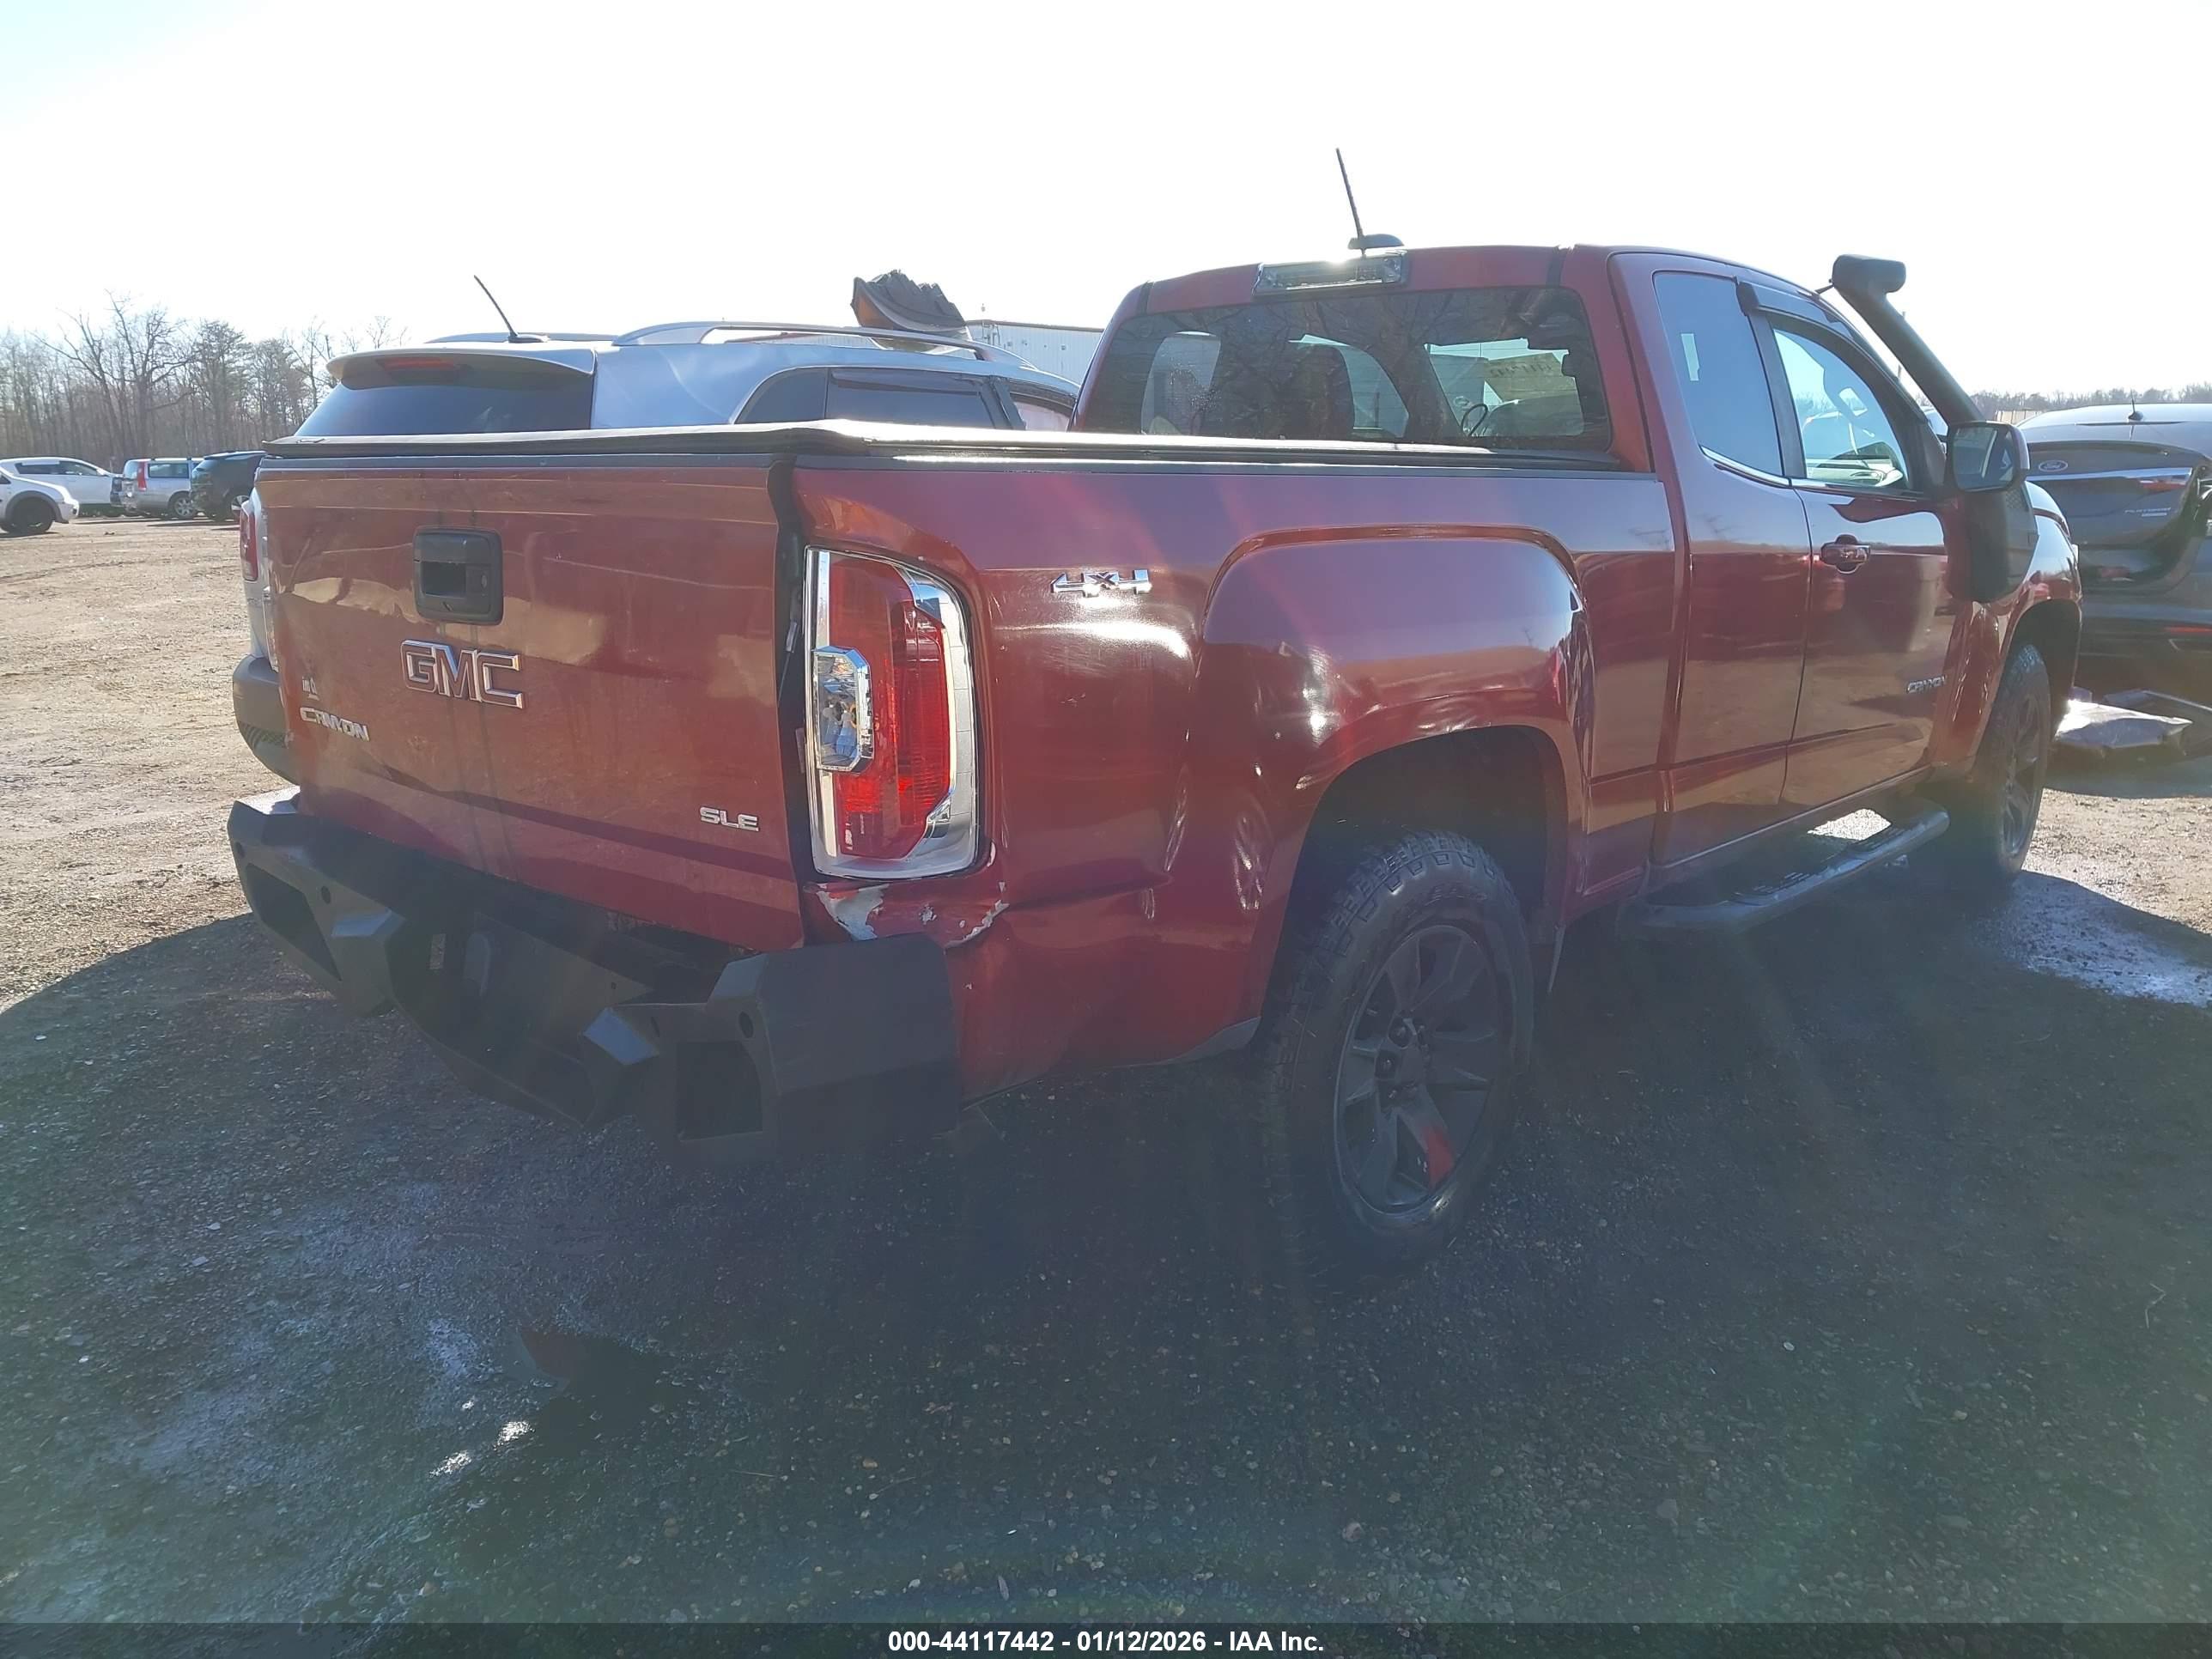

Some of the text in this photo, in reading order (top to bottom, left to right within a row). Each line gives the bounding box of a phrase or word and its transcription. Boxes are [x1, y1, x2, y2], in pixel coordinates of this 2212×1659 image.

[400, 640, 524, 709] GMC
[300, 707, 370, 742] CANYON
[700, 806, 760, 832] SLE
